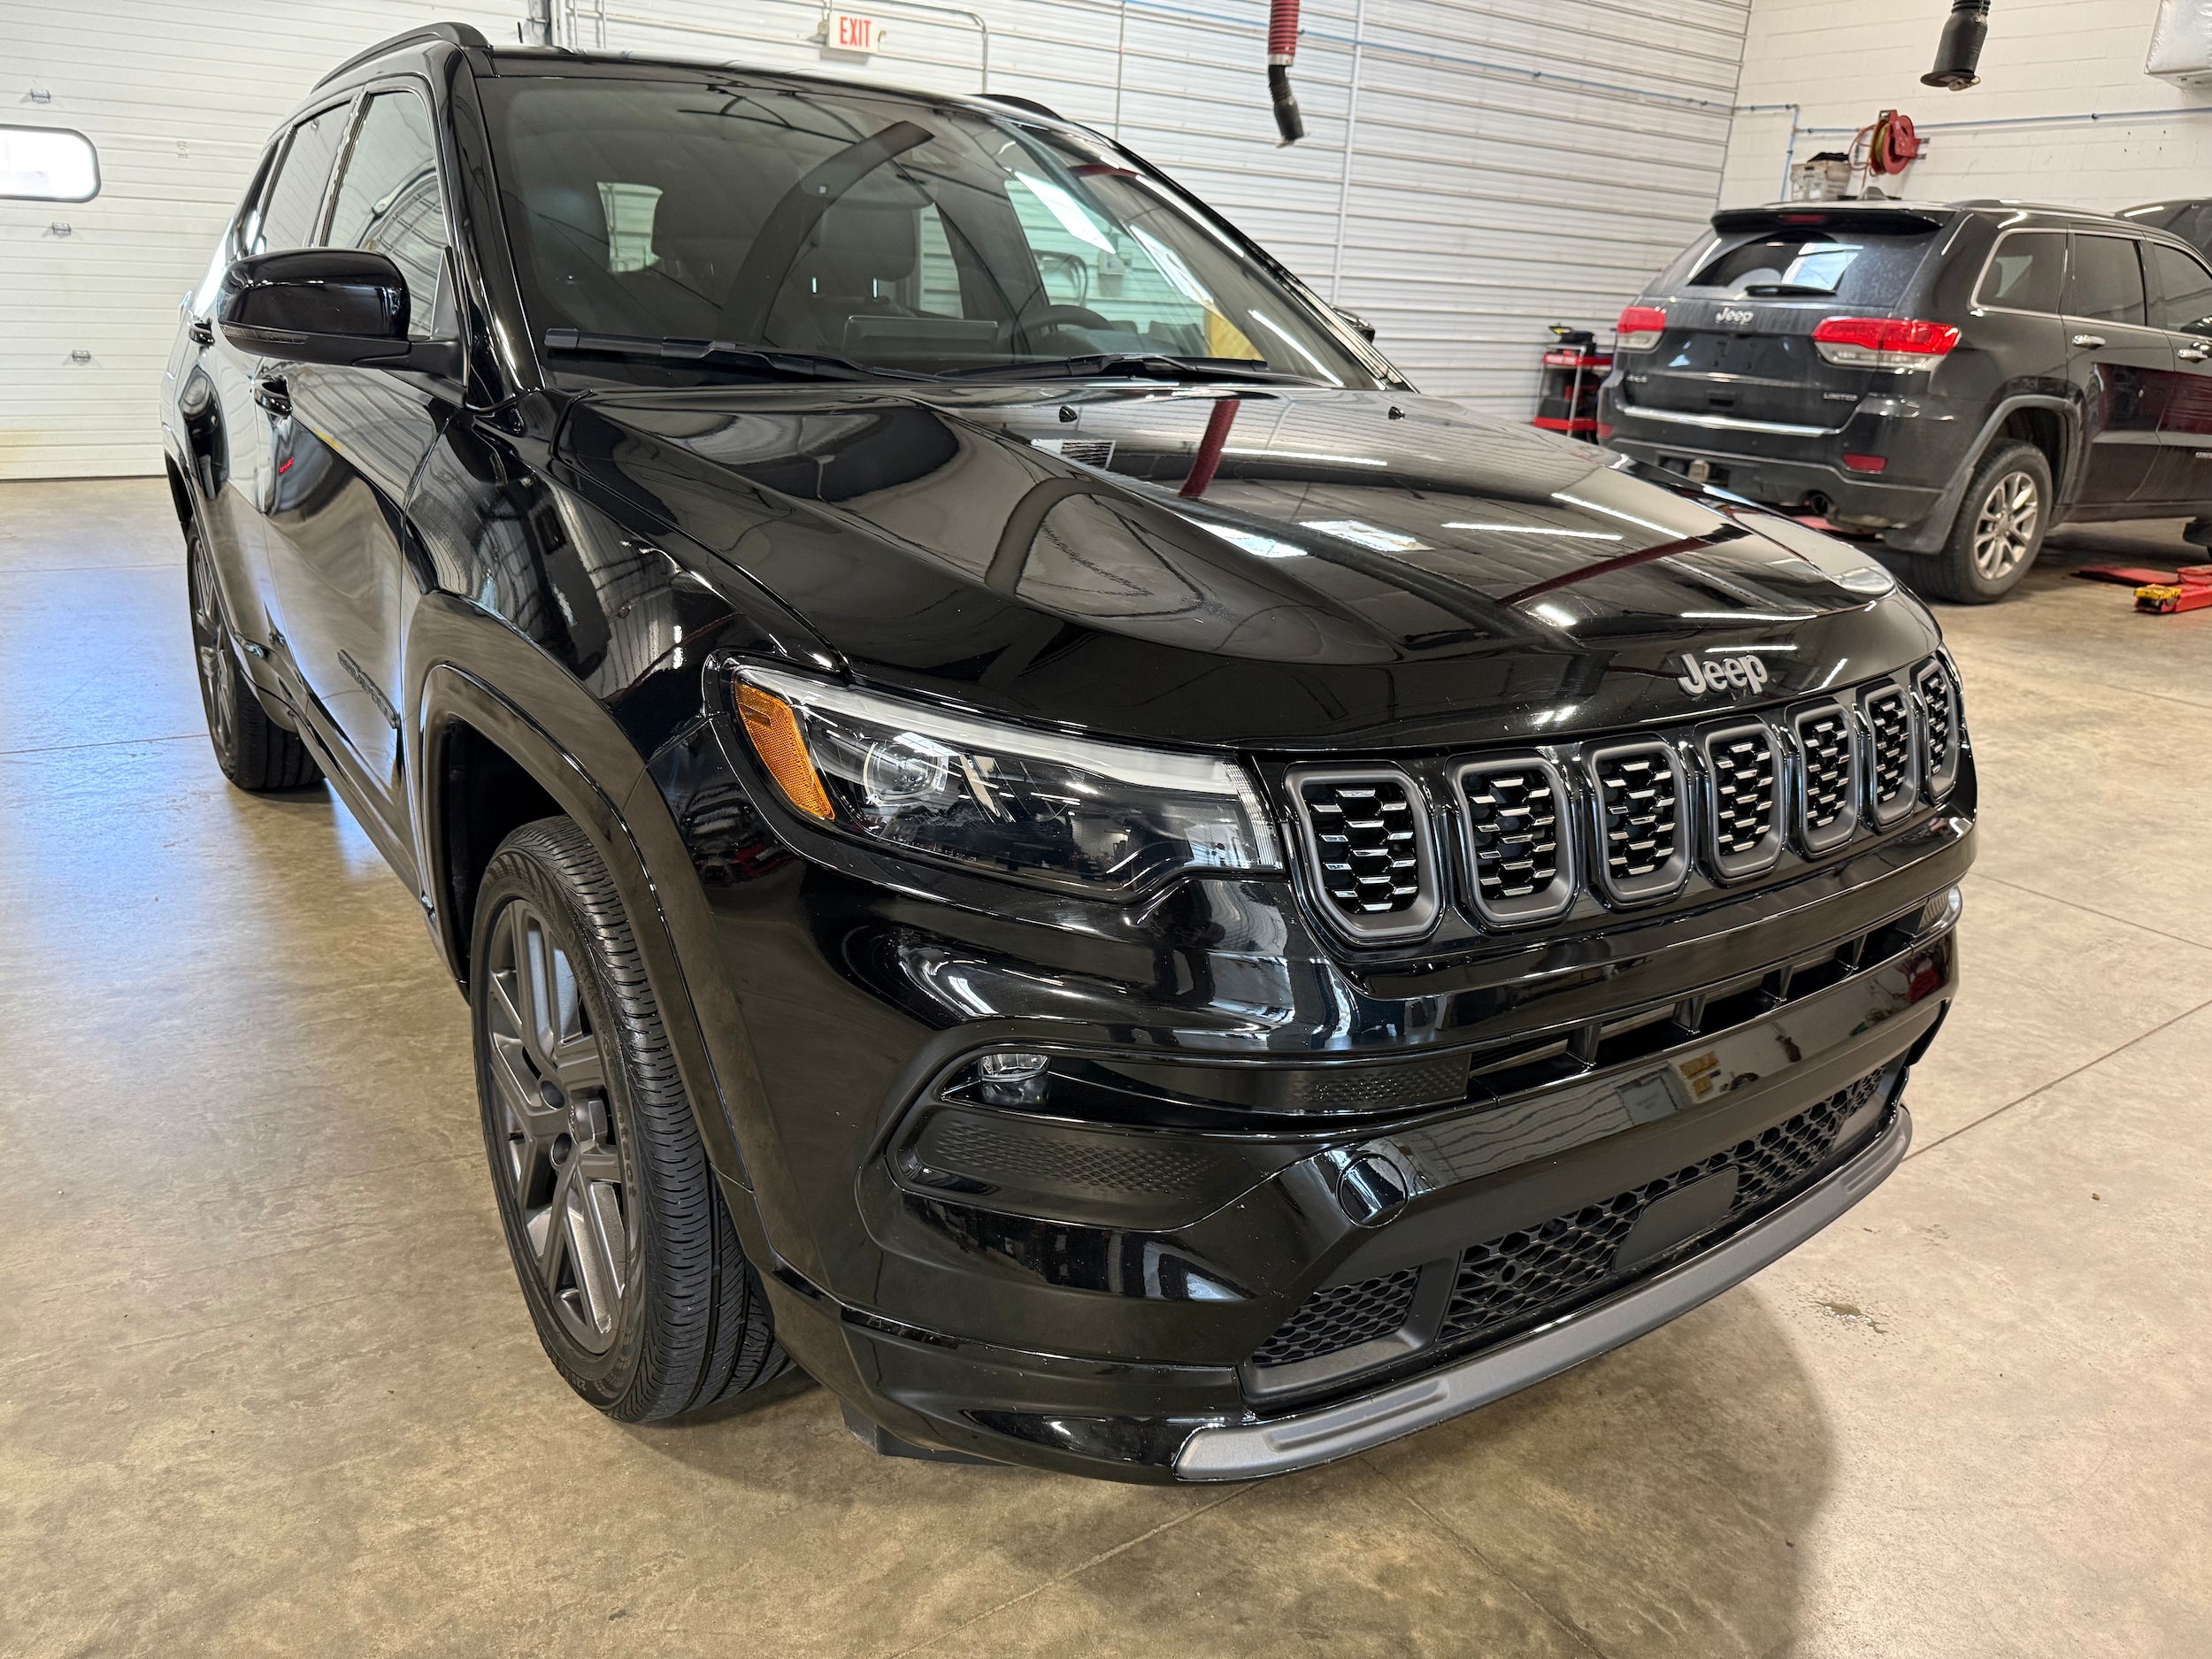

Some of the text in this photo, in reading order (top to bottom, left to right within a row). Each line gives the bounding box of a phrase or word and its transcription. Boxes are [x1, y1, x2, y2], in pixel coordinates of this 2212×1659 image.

[840, 16, 872, 48] EXIT
[1715, 305, 1755, 326] Jeep
[1676, 653, 1768, 695] Jeep
